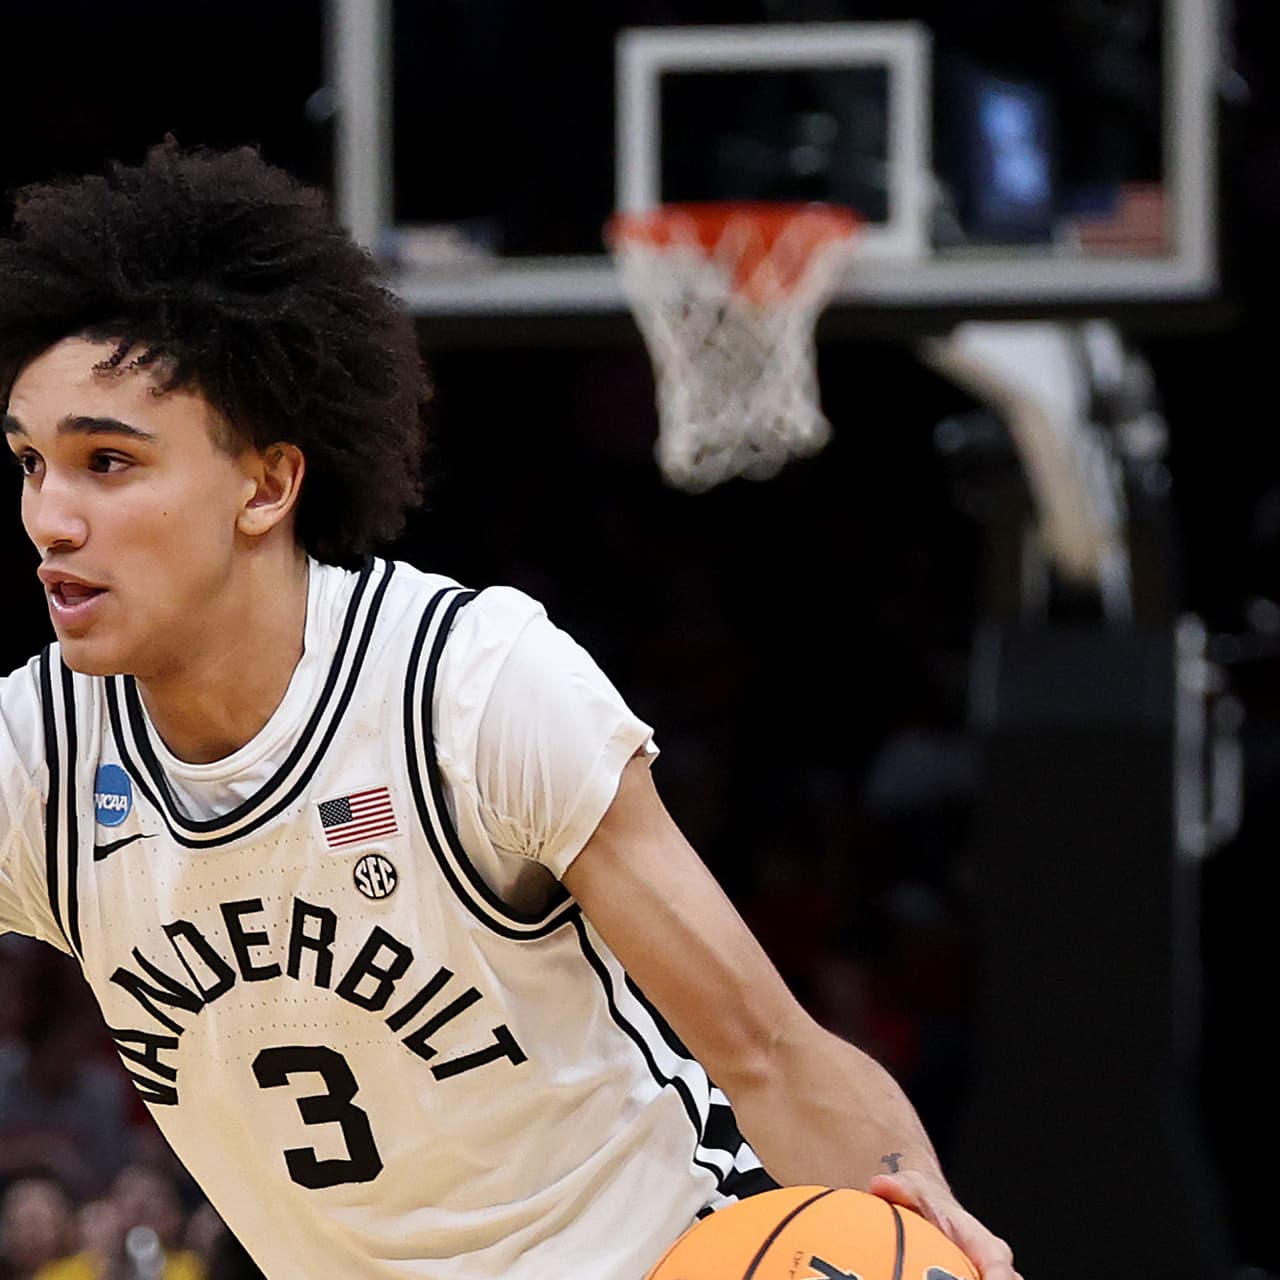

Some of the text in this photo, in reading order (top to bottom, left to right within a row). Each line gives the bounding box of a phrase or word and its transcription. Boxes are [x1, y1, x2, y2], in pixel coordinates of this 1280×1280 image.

[94, 793, 128, 811] NCAA
[355, 855, 396, 898] SEC
[108, 897, 528, 1106] VANDERBILT
[251, 1045, 383, 1190] 3
